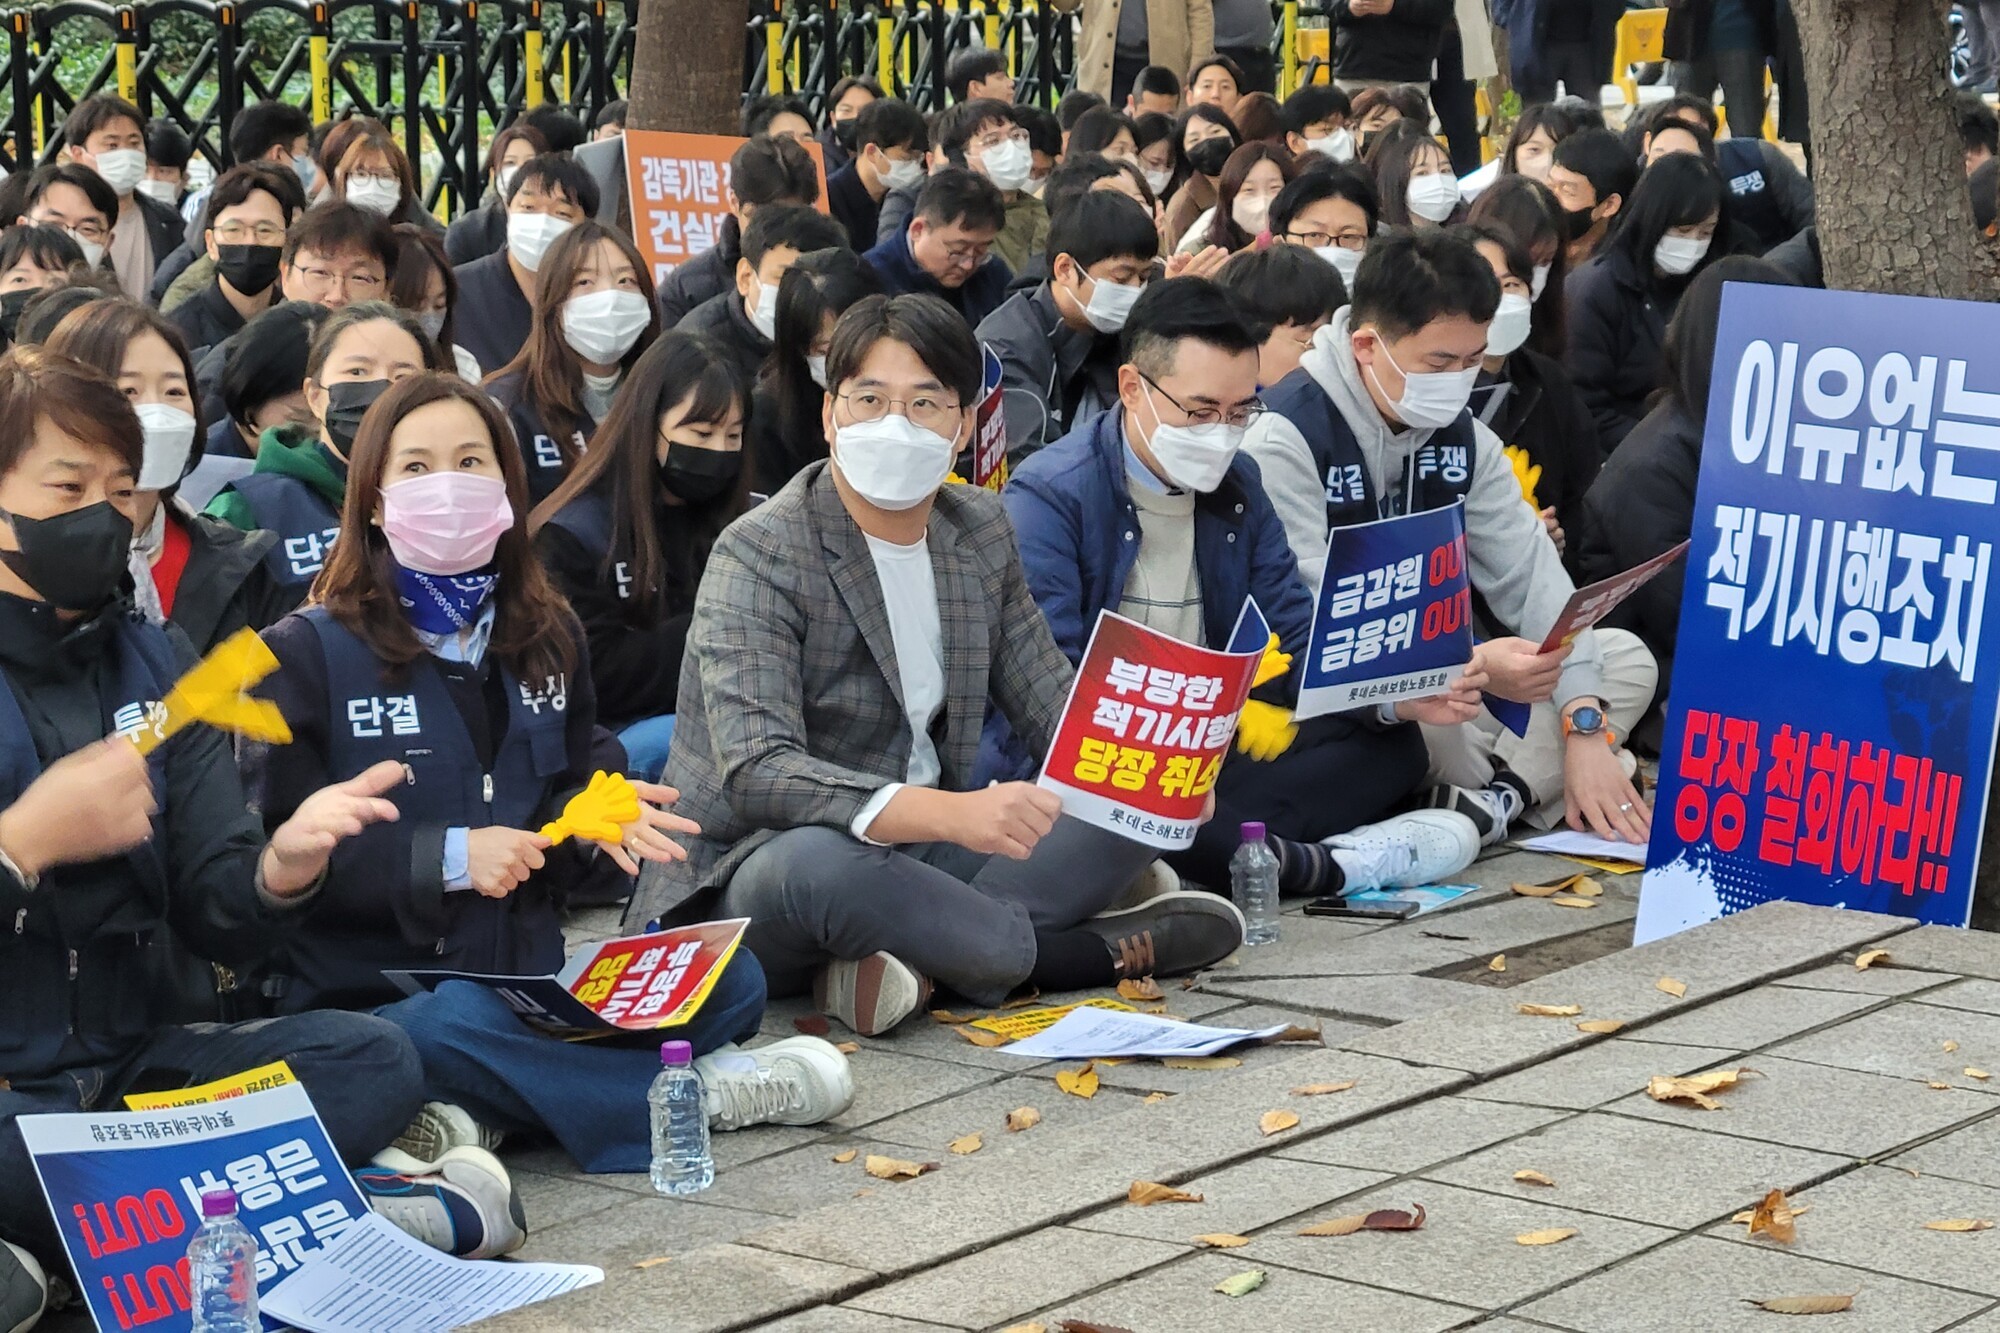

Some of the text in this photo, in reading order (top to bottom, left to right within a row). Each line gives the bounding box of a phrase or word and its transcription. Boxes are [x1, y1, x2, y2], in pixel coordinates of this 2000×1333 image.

[641, 156, 720, 204] 감독기관
[1730, 170, 1765, 195] 투쟁
[534, 430, 588, 469] 단
[1731, 339, 2000, 505] 이유없는
[1331, 553, 1424, 620] 금감원
[1706, 504, 1993, 683] 적기시행조치
[1320, 607, 1417, 673] 금융위
[1105, 656, 1224, 711] 부당한
[1348, 672, 1448, 702] 롯데손해보험노동조합
[347, 695, 421, 737] 단결
[1092, 696, 1238, 750] 적기시행
[1073, 736, 1157, 793] 당장
[1674, 709, 1963, 897] 당장 철회하라!!
[628, 940, 704, 1017] 부당한
[90, 1110, 236, 1143] 롯데손해보험노동조합
[73, 1138, 328, 1260] 금융위 OUT!
